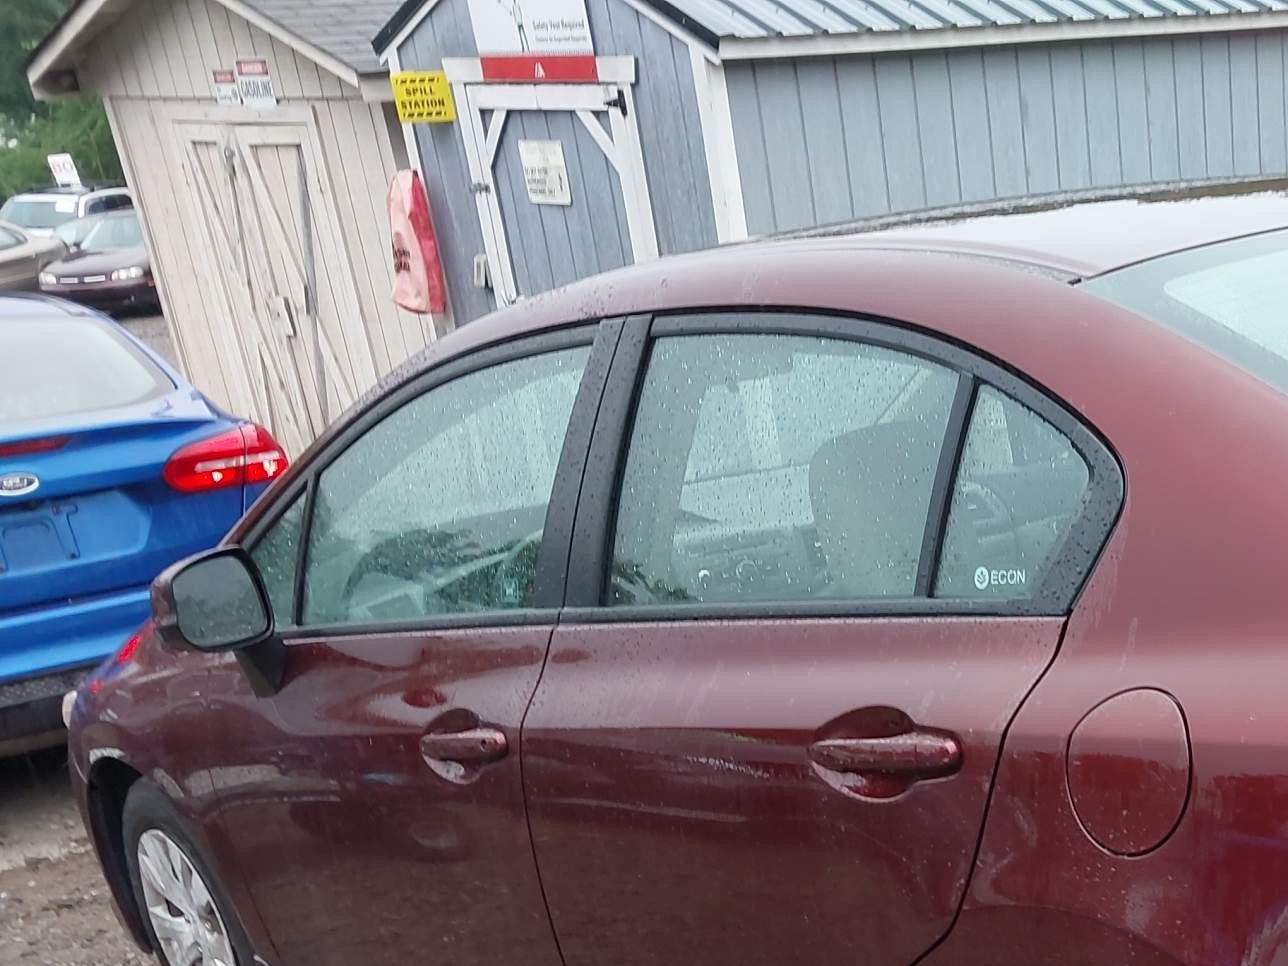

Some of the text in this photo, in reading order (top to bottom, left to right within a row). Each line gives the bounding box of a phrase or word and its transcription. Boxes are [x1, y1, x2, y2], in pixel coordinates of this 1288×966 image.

[240, 79, 272, 98] GASOLINE
[405, 86, 435, 97] SPILL
[400, 98, 446, 110] STATION
[990, 569, 1026, 585] ECON
